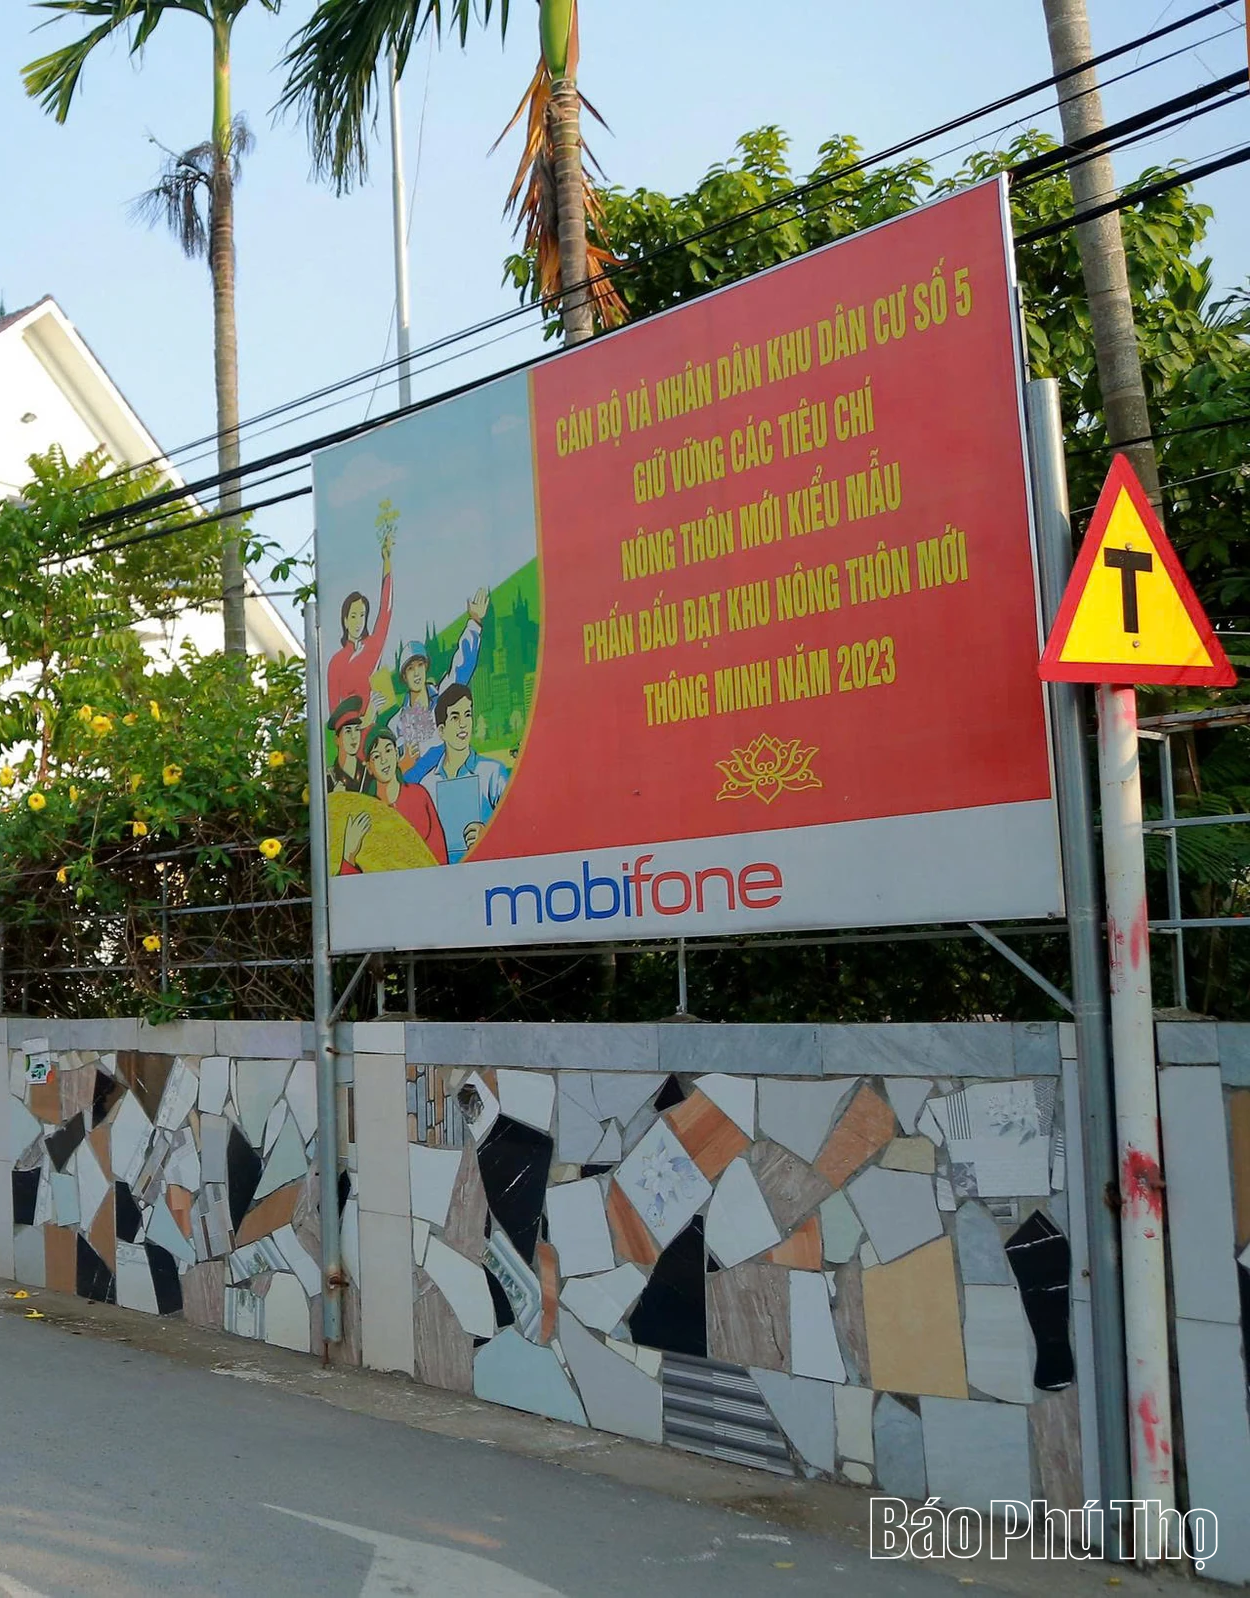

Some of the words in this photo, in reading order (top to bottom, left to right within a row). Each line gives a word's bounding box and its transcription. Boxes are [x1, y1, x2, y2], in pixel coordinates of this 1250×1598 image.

[556, 404, 592, 457] CÁN
[597, 389, 622, 447] BỘ
[626, 378, 652, 431] VÀ
[656, 361, 712, 422] NHÂN
[717, 343, 761, 399] DÂN
[767, 326, 811, 383] KHU
[818, 304, 866, 366] DÂN
[873, 285, 907, 345] CƯ
[913, 257, 948, 332] SỐ
[954, 267, 972, 317] 5
[633, 451, 666, 504] GIỮ
[670, 437, 725, 492] VỮNG
[731, 414, 774, 473] CÁC
[778, 398, 828, 459] TIÊU
[834, 376, 874, 442] CHÍ
[621, 529, 675, 581] NÔNG
[680, 505, 733, 562] THÔN
[739, 489, 781, 551] MỚI
[787, 465, 839, 536] KIỂU
[845, 449, 901, 521] MẪU
[583, 601, 634, 664] PHẤN
[639, 590, 678, 652] ĐẤU
[683, 592, 720, 648] ĐẠT
[726, 581, 770, 632] KHU
[776, 562, 840, 621] NÔNG
[845, 541, 910, 606] THÔN
[917, 523, 970, 590] MỚI
[644, 671, 708, 726] THÔNG
[714, 658, 771, 714] MINH
[778, 644, 829, 703] NĂM
[837, 636, 896, 691] 2023
[485, 854, 782, 926] mobifone
